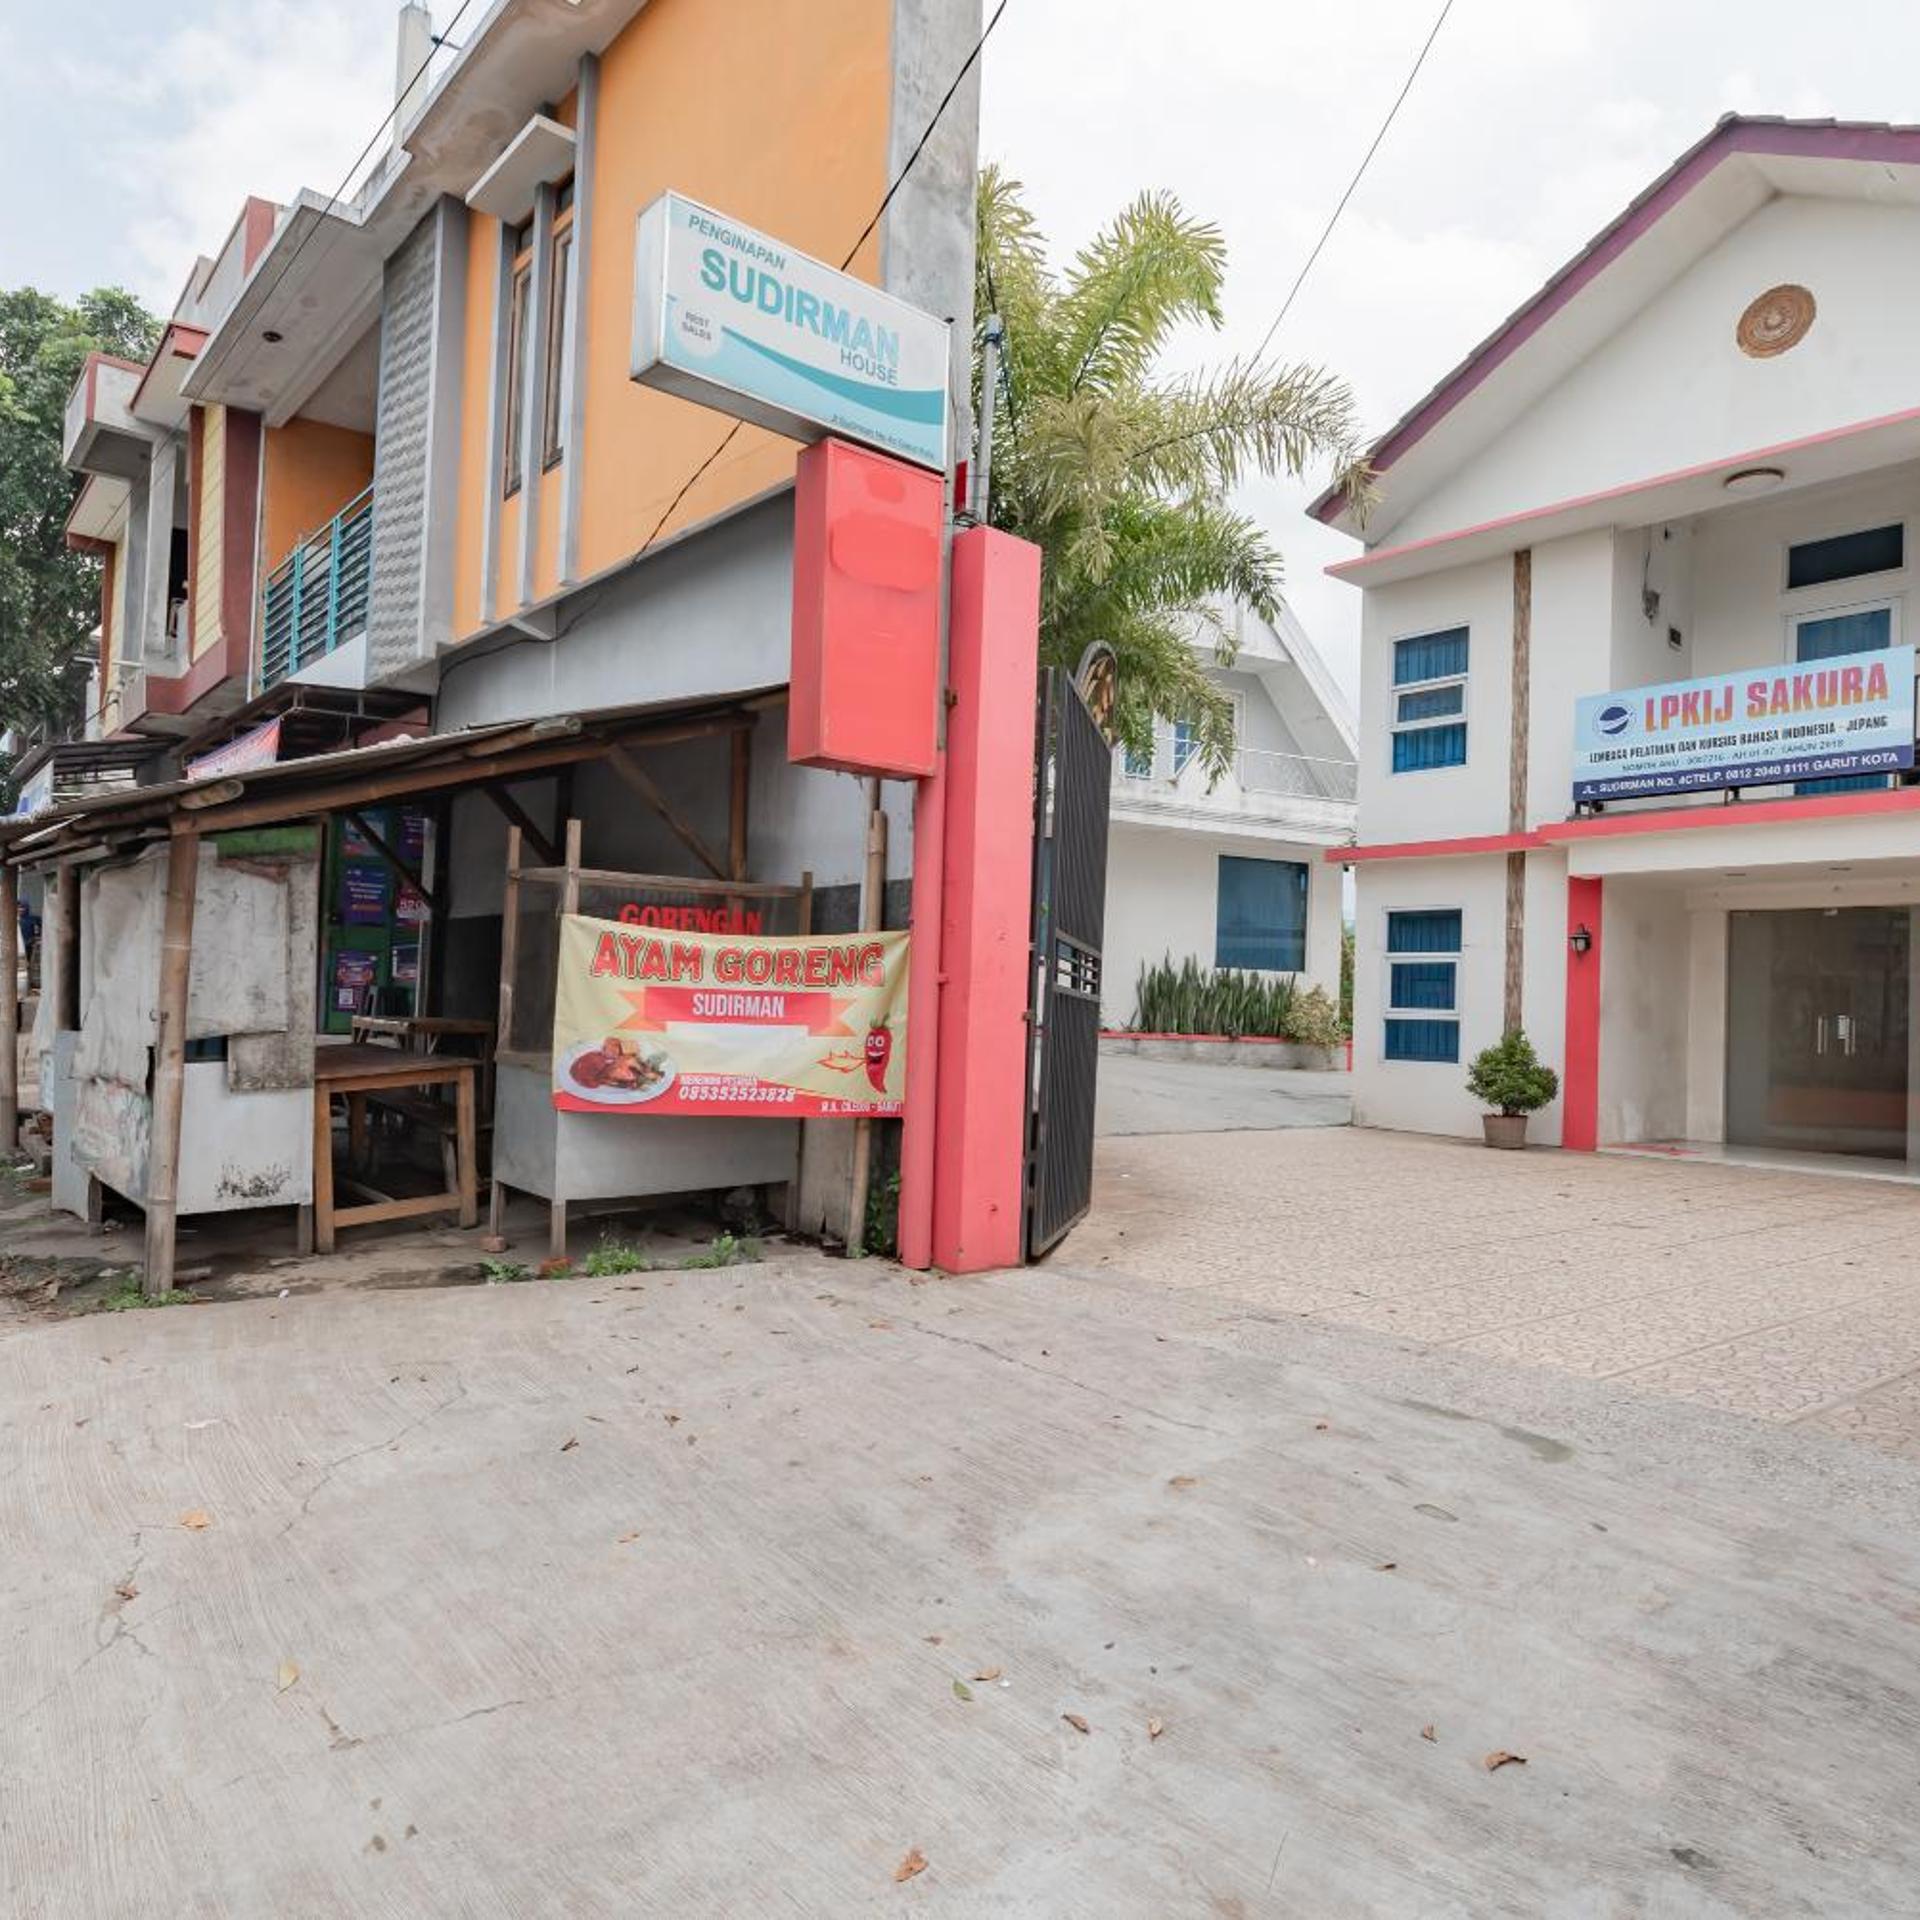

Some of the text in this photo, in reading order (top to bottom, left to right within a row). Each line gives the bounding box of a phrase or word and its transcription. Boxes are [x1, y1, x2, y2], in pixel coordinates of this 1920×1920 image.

[688, 214, 785, 270] PENGINAPAN
[700, 248, 899, 367] SUDIRMAN
[840, 347, 898, 386] HOUSE
[1645, 662, 1888, 732] LPKIJ SAKURA
[1590, 750, 1627, 764] LEMBAGA
[1630, 745, 1675, 758] PELATIHAN
[1678, 740, 1696, 752] DAN
[1699, 735, 1737, 750] KURSUS
[1740, 729, 1779, 745] BAHASA
[1782, 722, 1836, 740] INDONESIA
[1846, 716, 1888, 731] JEPANG
[1599, 778, 1654, 793] SUDIRMAN
[1812, 756, 1859, 772] GARUT
[1862, 751, 1898, 766] KOTA
[619, 903, 762, 936] GORENGAN
[590, 931, 886, 988] AYAM GORENG
[692, 992, 785, 1018] SUDIRMAN
